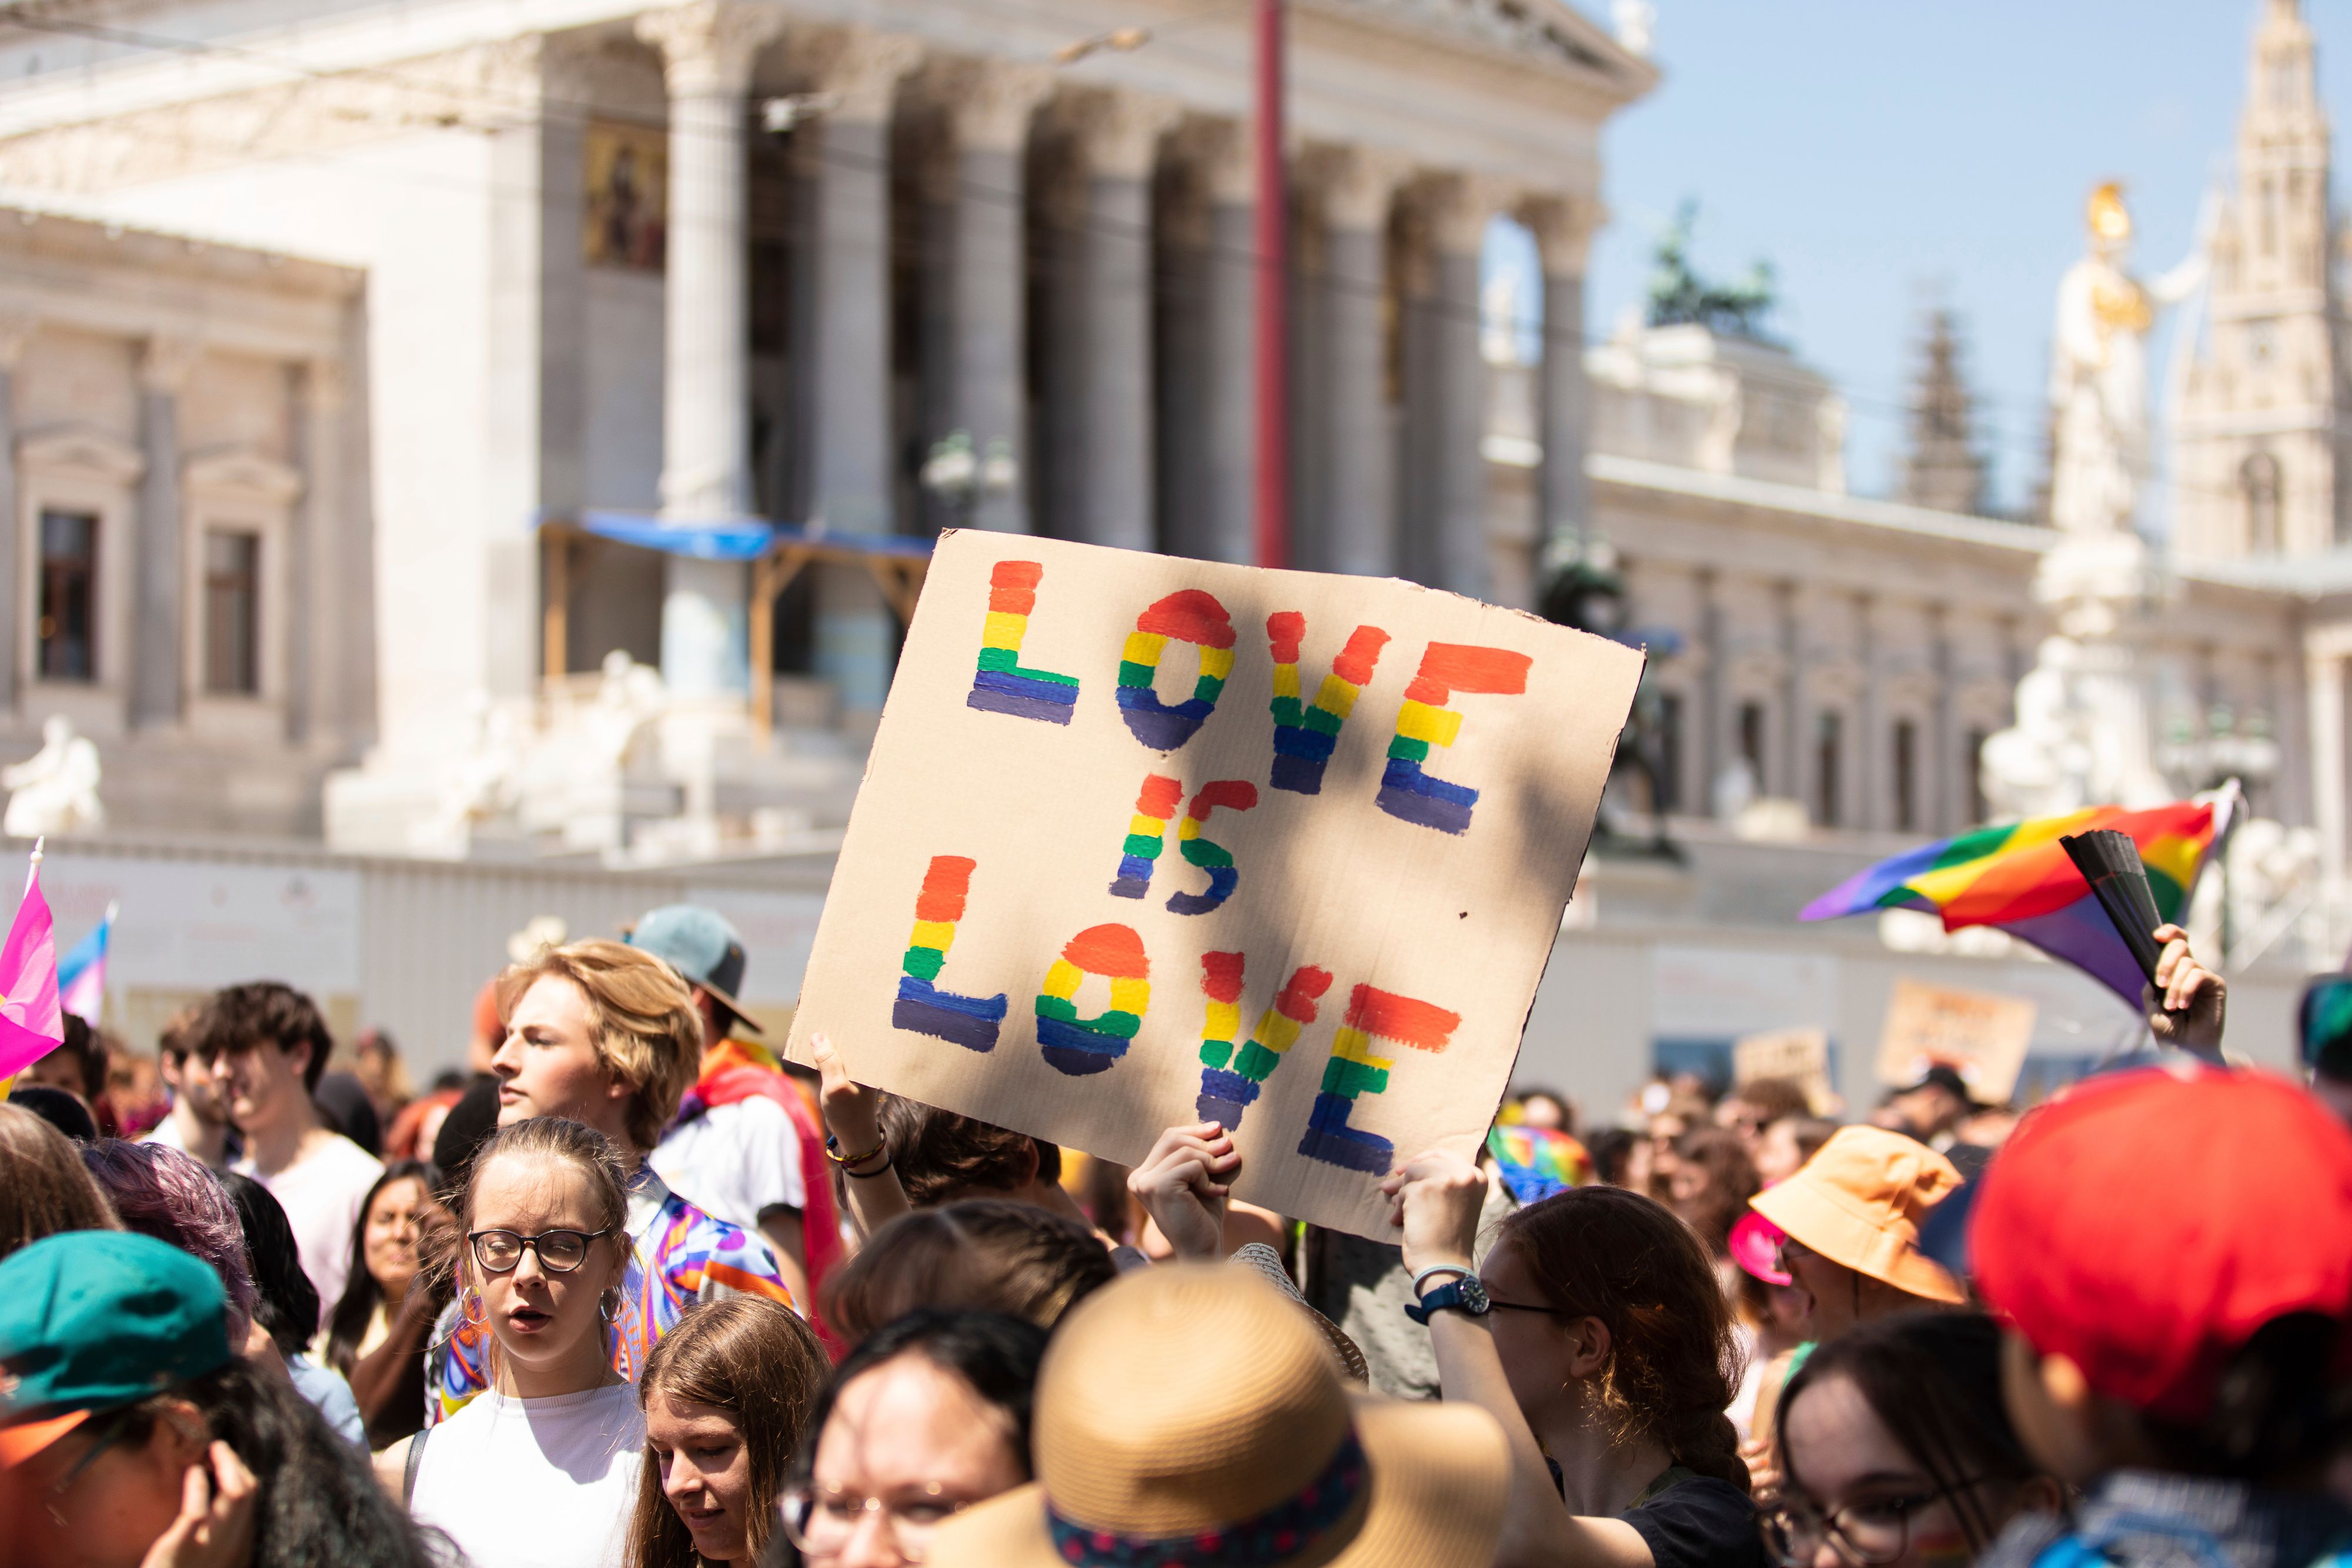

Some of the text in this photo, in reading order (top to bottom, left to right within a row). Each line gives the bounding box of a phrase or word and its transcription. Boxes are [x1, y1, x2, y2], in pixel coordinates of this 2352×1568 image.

[967, 560, 1533, 835] LOVE
[1109, 774, 1257, 915] IS
[892, 855, 1461, 1176] LOVE
